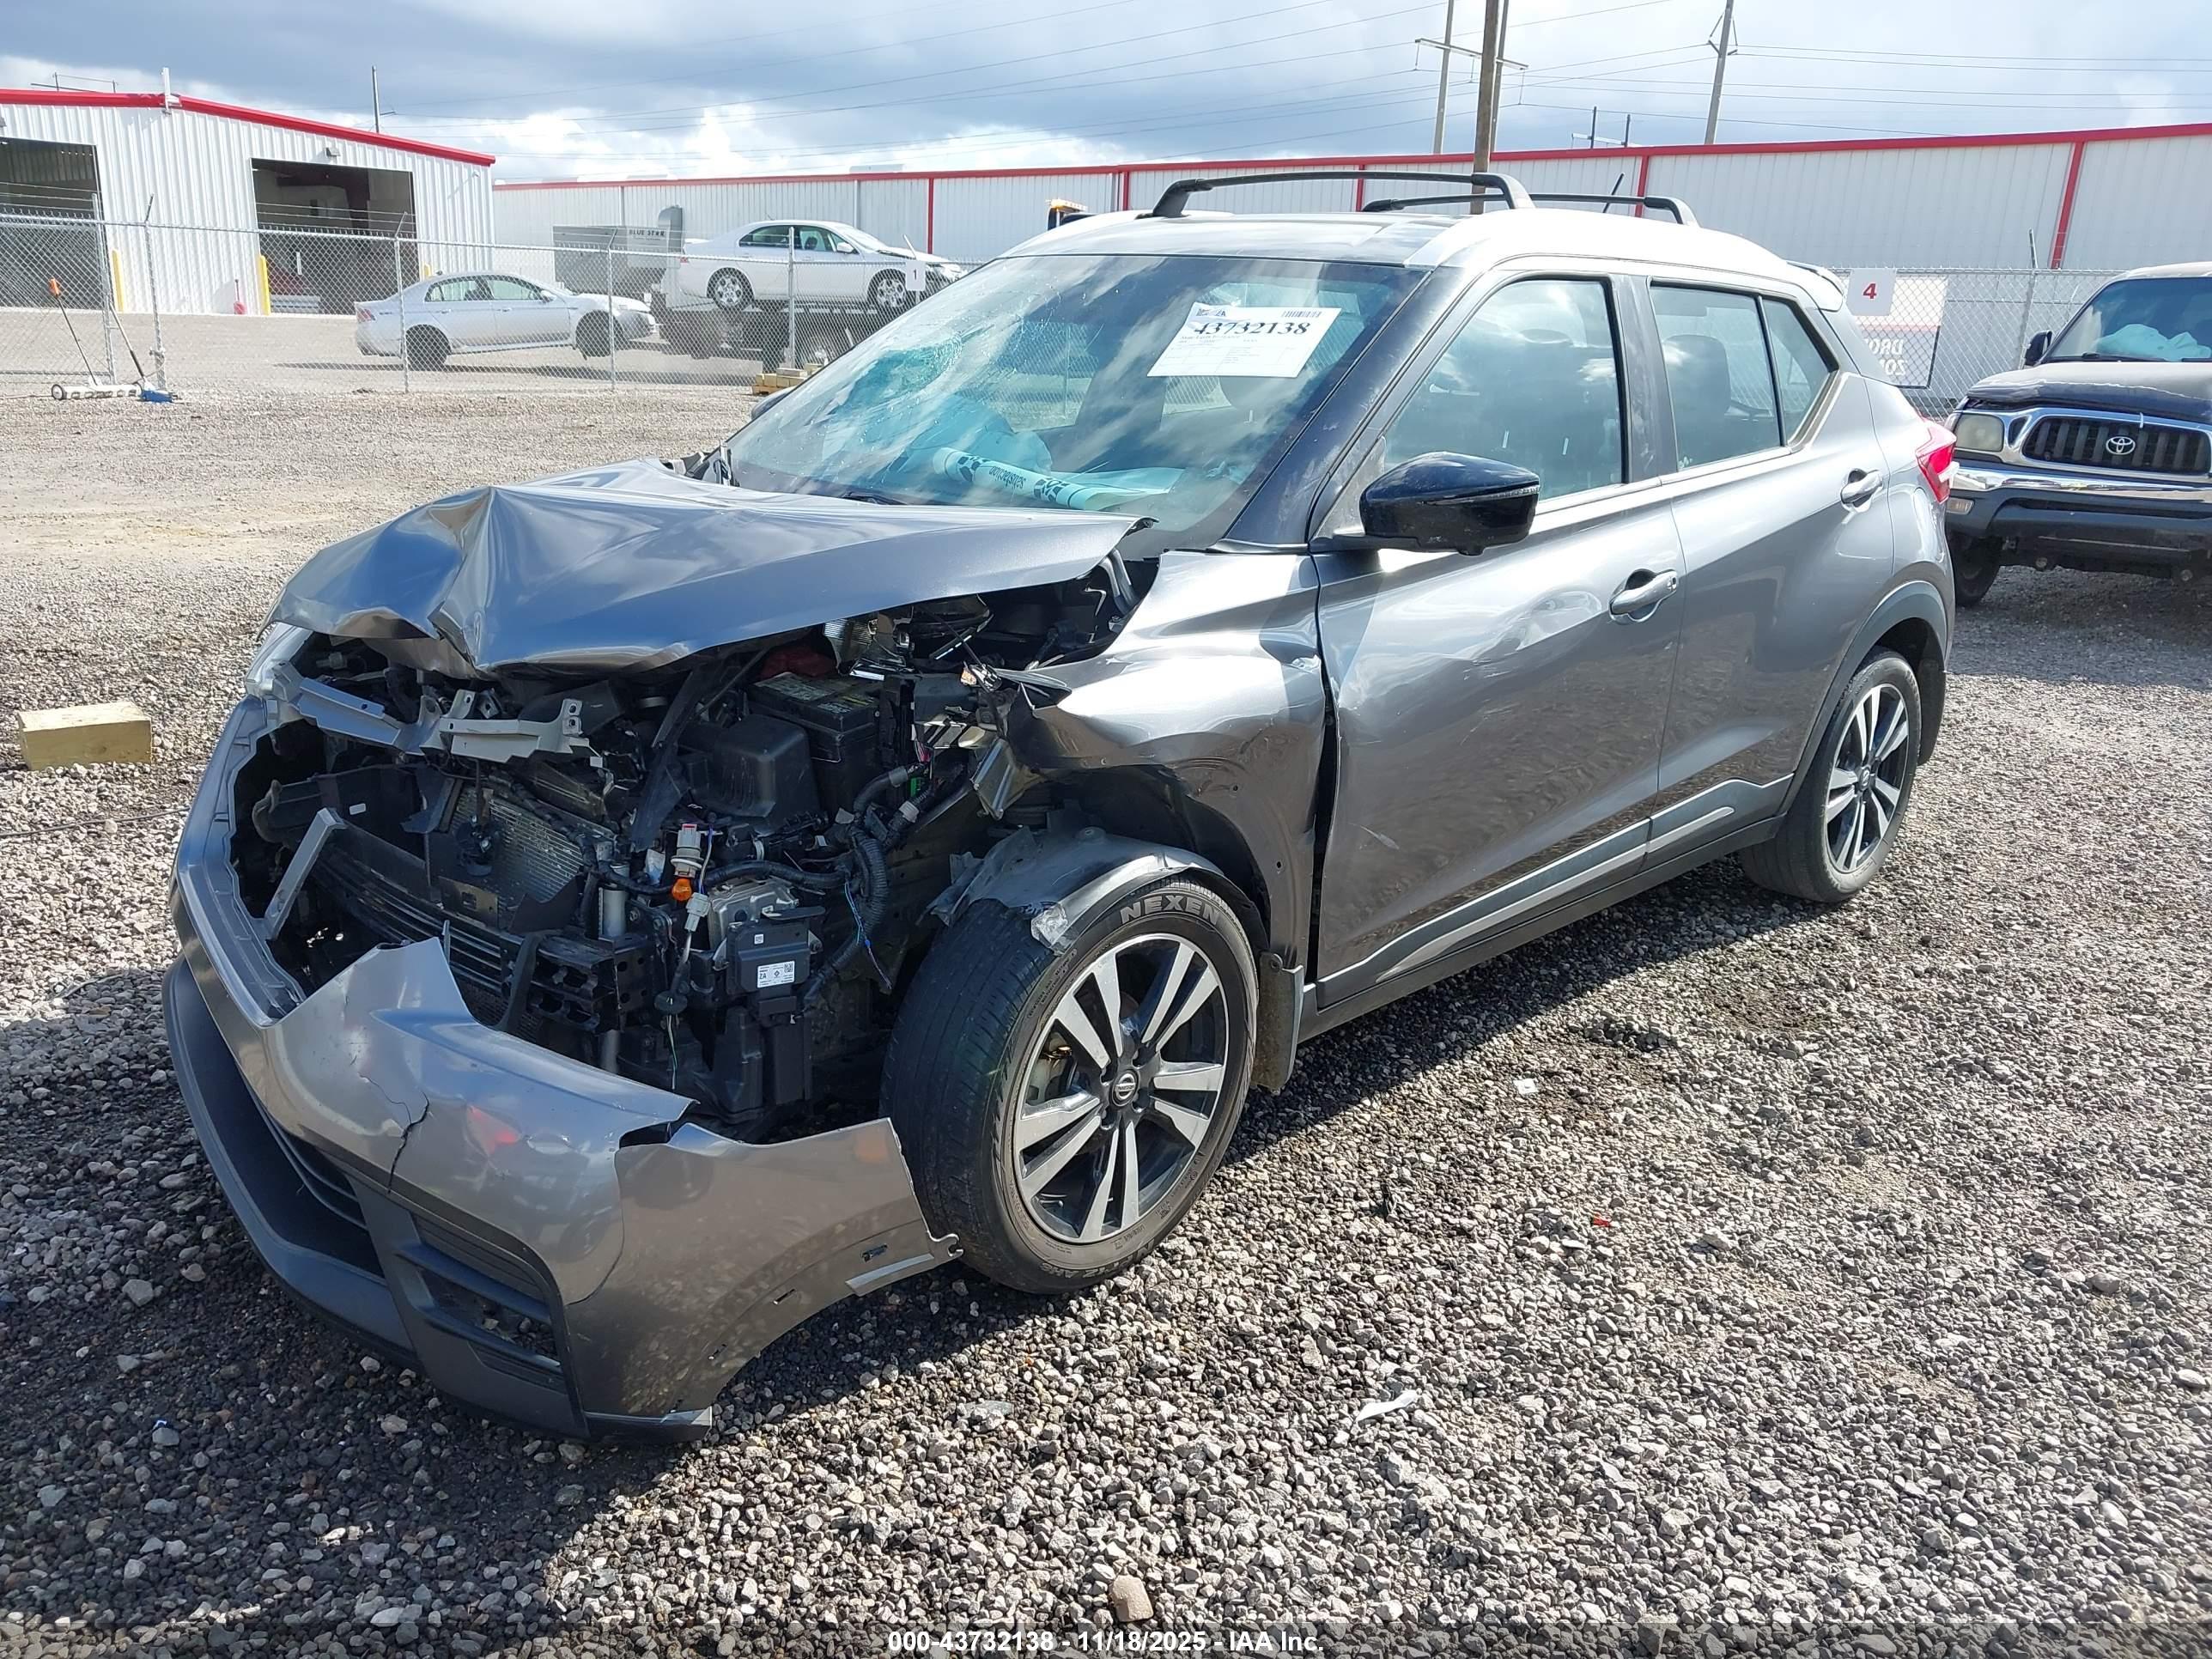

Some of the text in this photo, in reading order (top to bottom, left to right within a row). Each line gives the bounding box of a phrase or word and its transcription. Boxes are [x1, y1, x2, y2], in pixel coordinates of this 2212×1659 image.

[913, 268, 917, 281] 1
[1863, 283, 1877, 300] 4
[1194, 322, 1311, 335] 43732138
[1120, 895, 1220, 926] NEXEN
